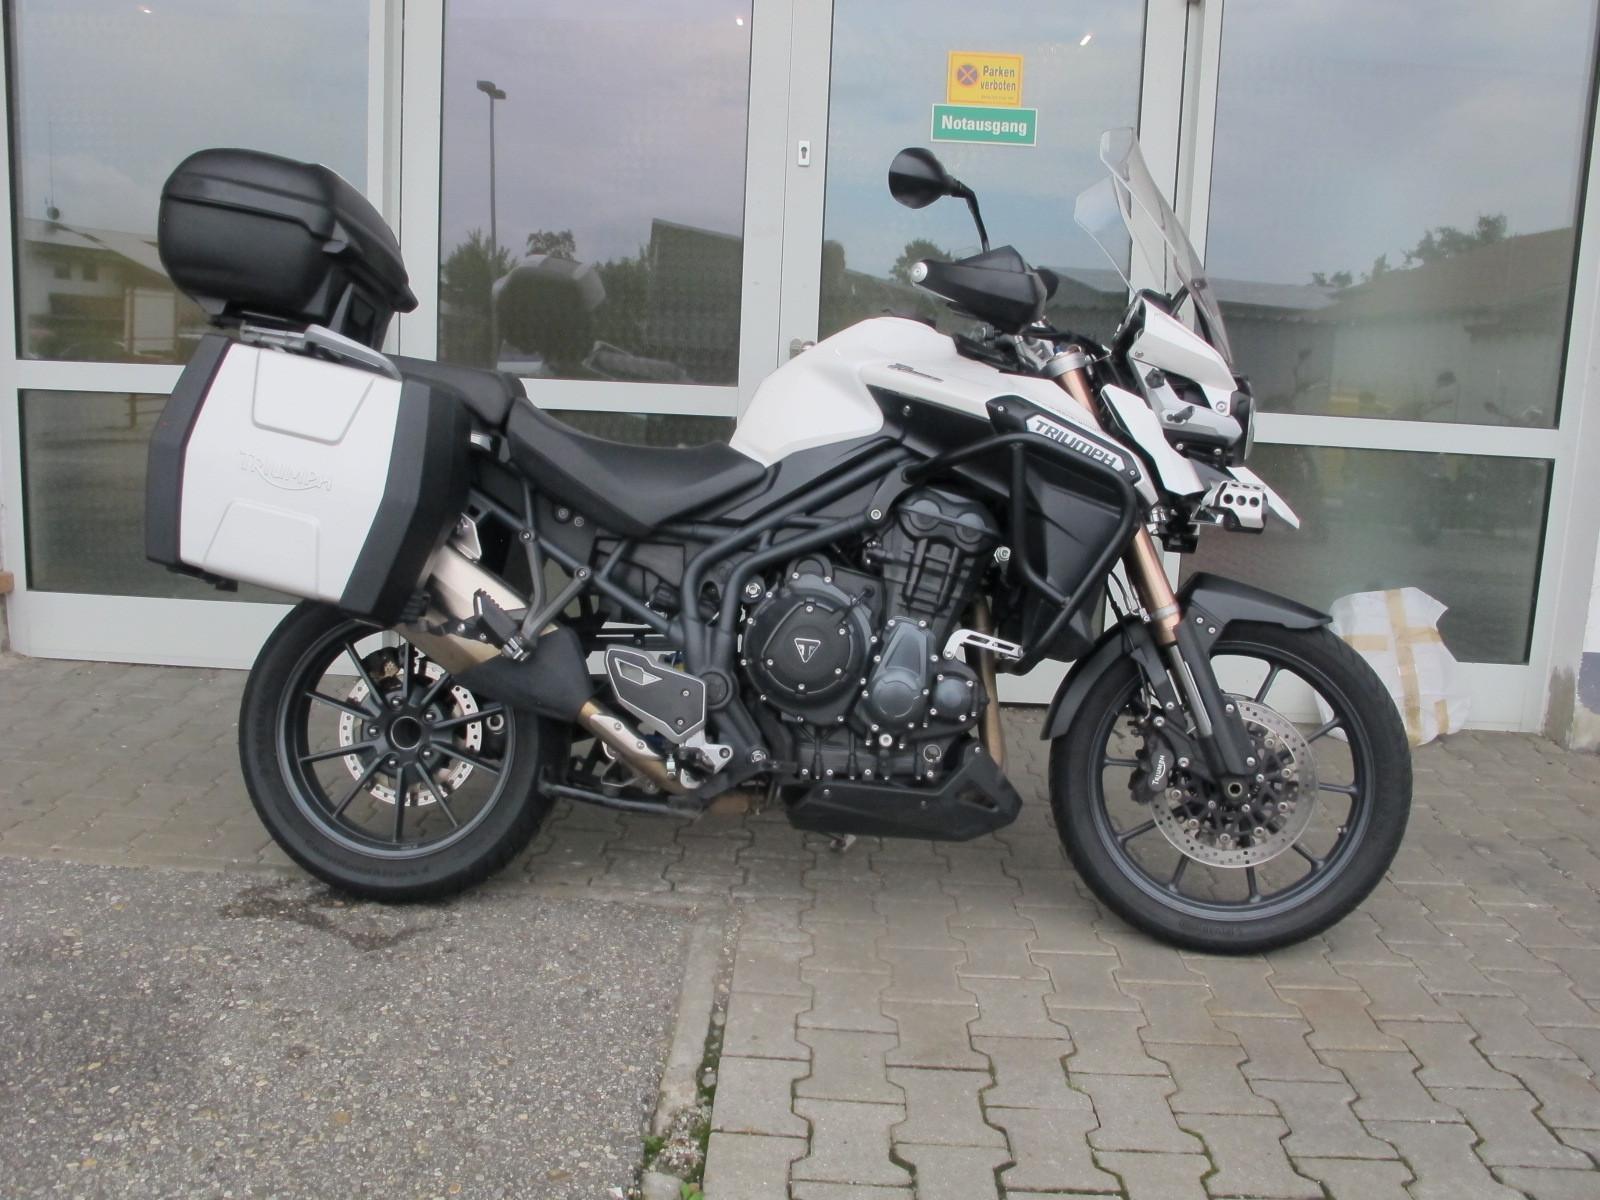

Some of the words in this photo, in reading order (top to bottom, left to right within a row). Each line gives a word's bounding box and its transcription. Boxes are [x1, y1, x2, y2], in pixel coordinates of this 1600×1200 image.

[983, 65, 1015, 78] Parken
[980, 79, 1016, 92] verboten
[941, 114, 1028, 137] Notausgang
[1034, 419, 1118, 467] TRIUMPH
[1151, 754, 1166, 785] TRIUMPH
